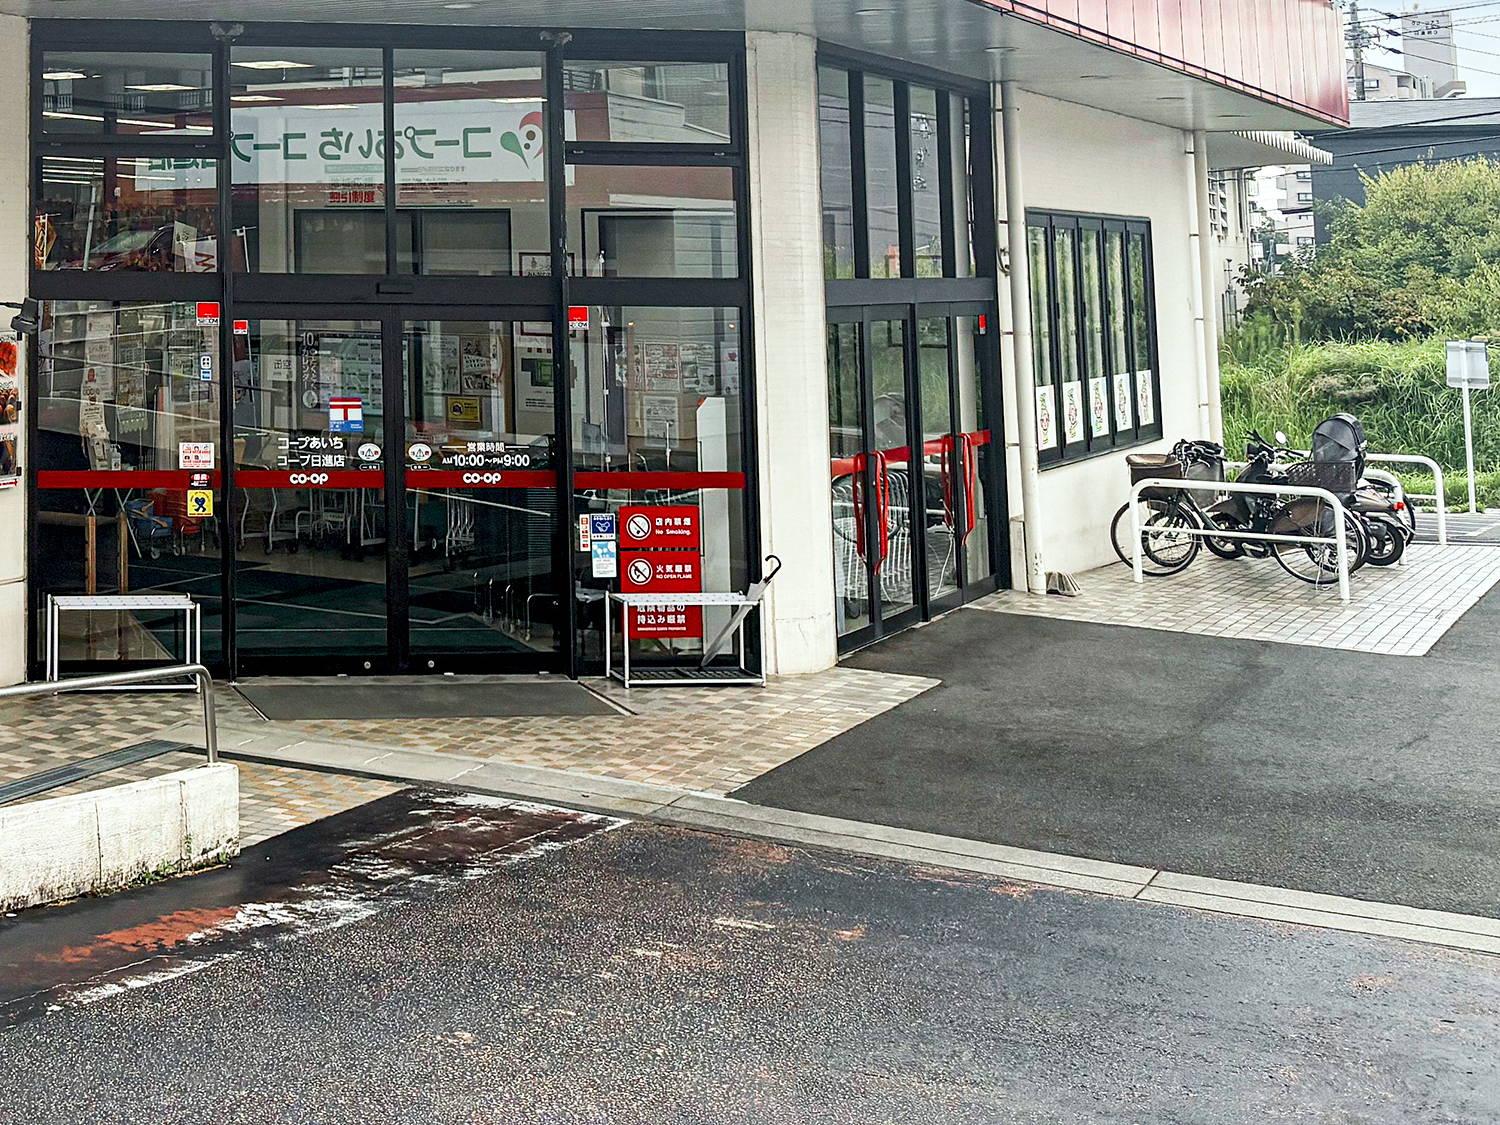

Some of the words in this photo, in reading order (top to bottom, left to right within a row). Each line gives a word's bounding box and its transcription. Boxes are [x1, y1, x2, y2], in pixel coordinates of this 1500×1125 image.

[277, 436, 343, 449] コープあいち
[466, 442, 505, 452] 営業時間
[277, 454, 345, 467] コープ日進店
